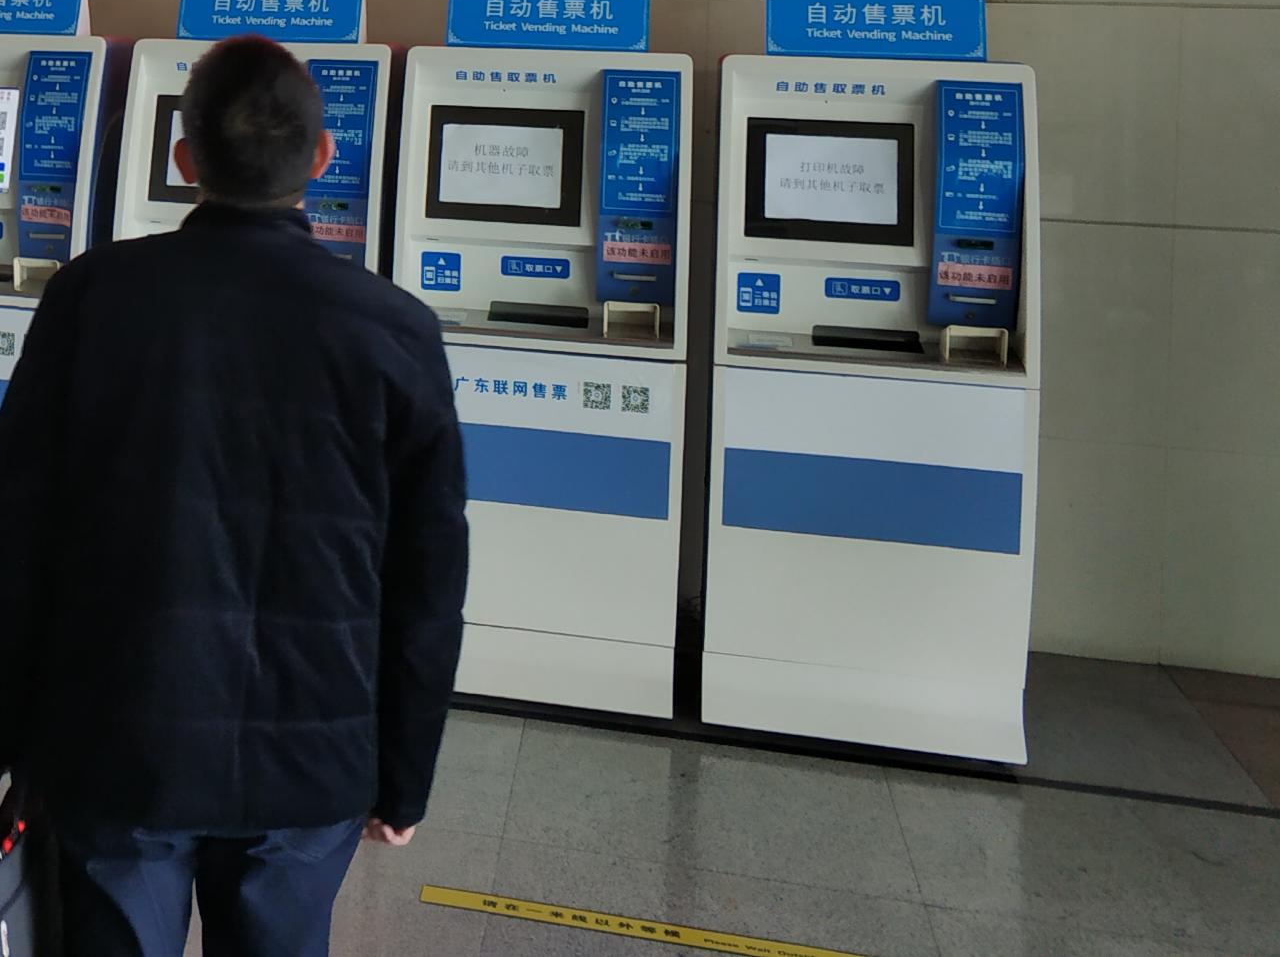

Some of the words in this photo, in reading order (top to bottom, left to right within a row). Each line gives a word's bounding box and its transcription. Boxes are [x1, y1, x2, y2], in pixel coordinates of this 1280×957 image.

[16, 10, 55, 20] Machine
[212, 15, 241, 25] Ticket
[246, 16, 286, 28] Vending
[291, 16, 333, 26] Machine
[807, 2, 946, 27] 自动售票机
[483, 21, 517, 32] Ticket
[521, 22, 567, 35] Vending
[571, 23, 619, 35] Machine
[806, 27, 842, 39] Ticket
[847, 28, 897, 42] Vending
[901, 30, 953, 41] Machine
[455, 70, 557, 84] 自助售取票机
[776, 81, 886, 96] 自助售取票机
[474, 142, 529, 158] 机器故障
[447, 158, 555, 178] 请到其他机子取票
[800, 161, 865, 175] 打印机故障
[780, 177, 885, 195] 请到其他机子取票
[454, 376, 568, 400] 广东联网售票
